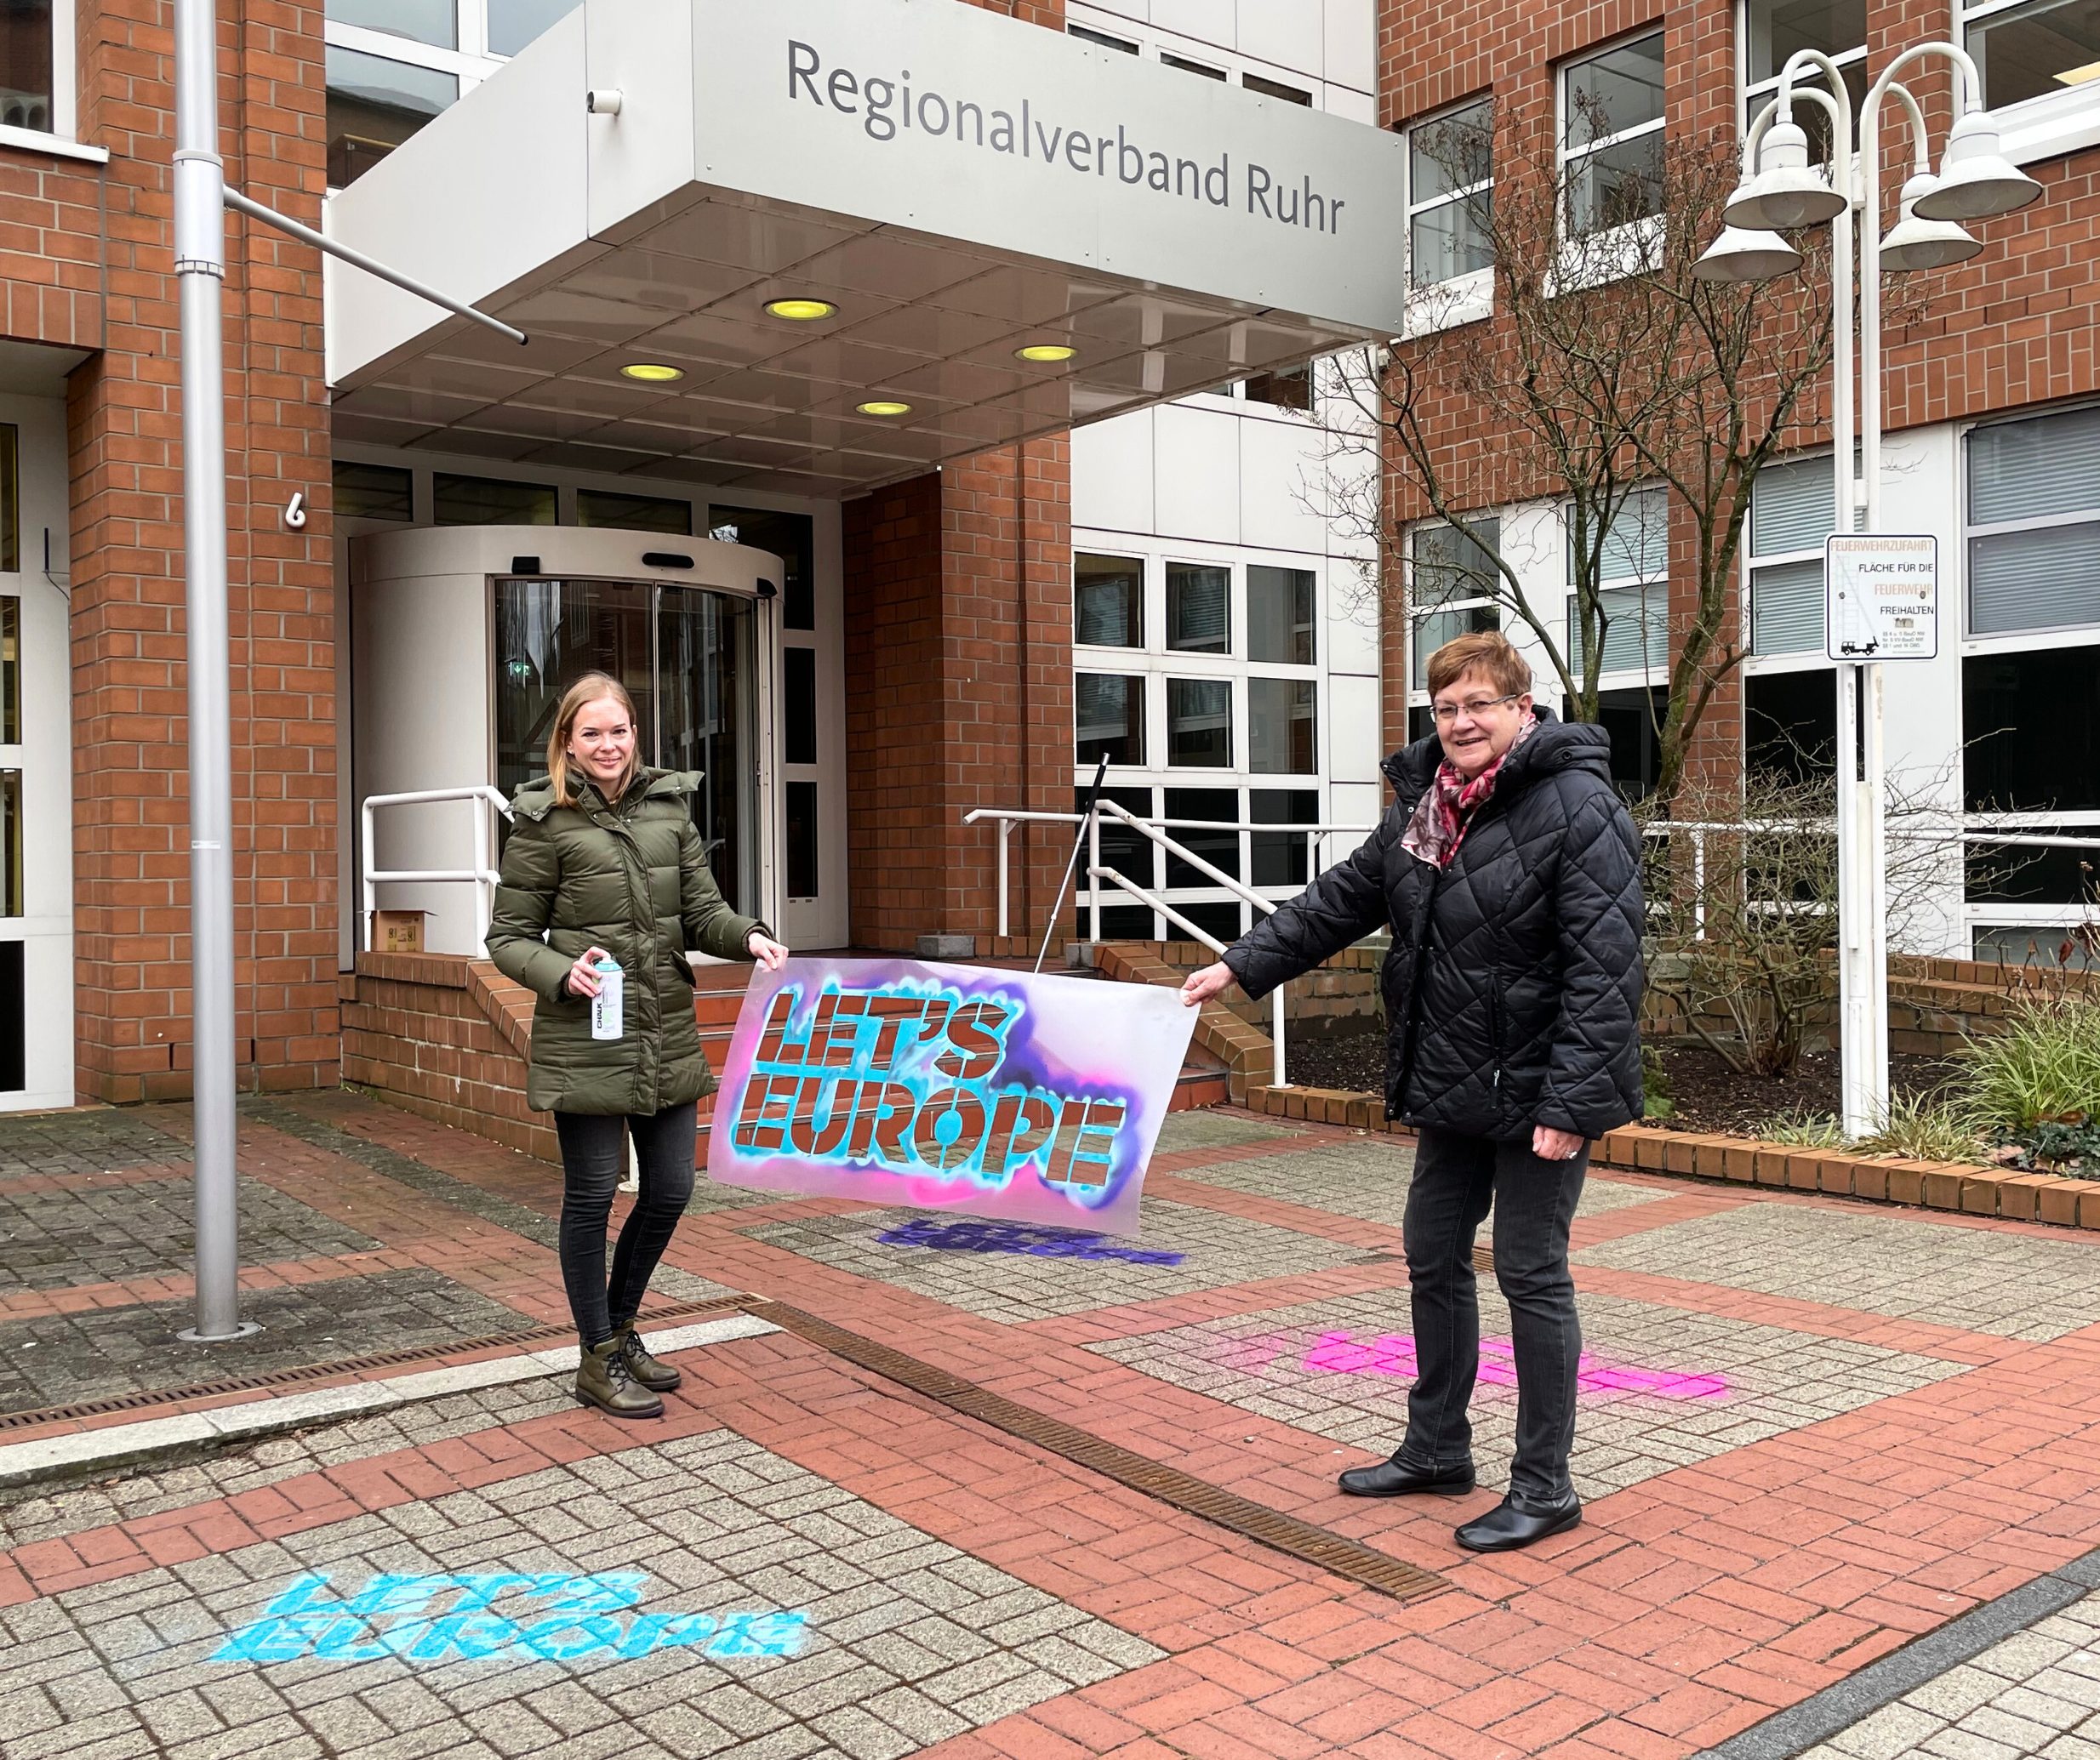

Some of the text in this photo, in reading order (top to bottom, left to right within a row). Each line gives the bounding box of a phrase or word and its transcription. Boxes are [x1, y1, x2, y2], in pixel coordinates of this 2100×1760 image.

[787, 39, 1345, 234] Regionalverband Ruhr
[285, 492, 305, 527] 6
[1830, 540, 1933, 552] FEUERWEHRZUFAHRT
[1858, 562, 1934, 572] FLÄCHE FÜR DIE
[1875, 584, 1933, 595] FEUERWEHR
[1880, 606, 1934, 615] FREIHALTEN
[756, 992, 1009, 1080] LET'S
[735, 1075, 1126, 1187] EUROPE
[208, 1610, 810, 1661] EUROPE
